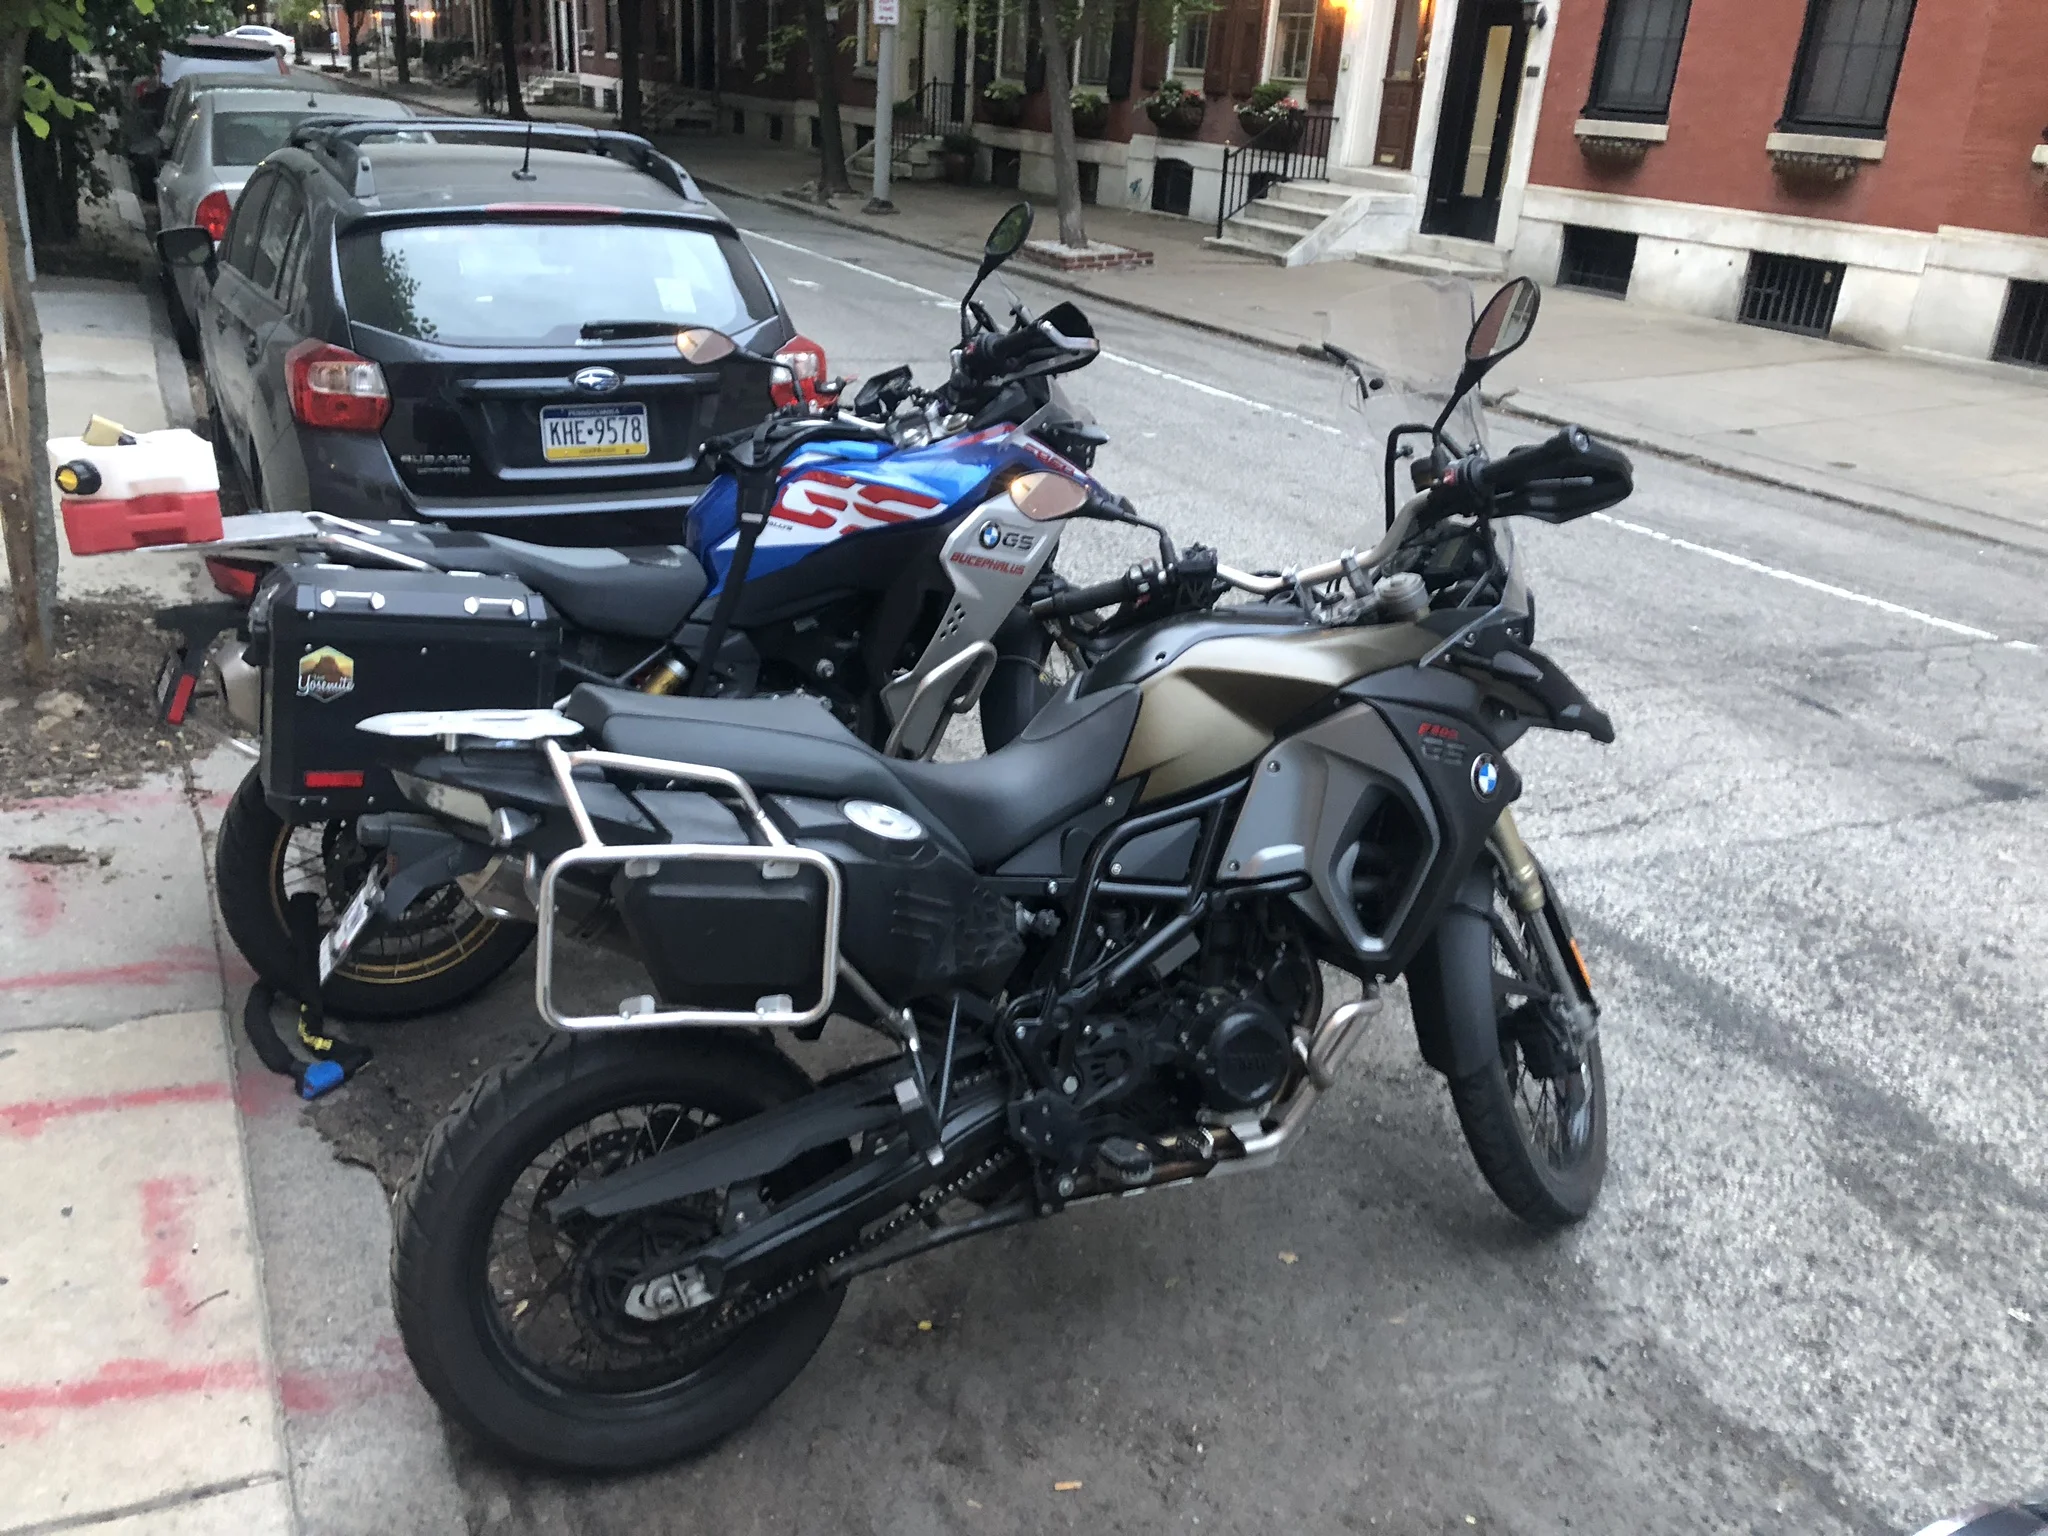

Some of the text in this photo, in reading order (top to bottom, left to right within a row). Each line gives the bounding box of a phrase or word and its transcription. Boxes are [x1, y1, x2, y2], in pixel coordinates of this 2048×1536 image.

[400, 454, 471, 465] SUBARU
[1002, 532, 1035, 550] GS
[950, 551, 1026, 576] BUCEPHALUS
[296, 674, 355, 697] Yosemite
